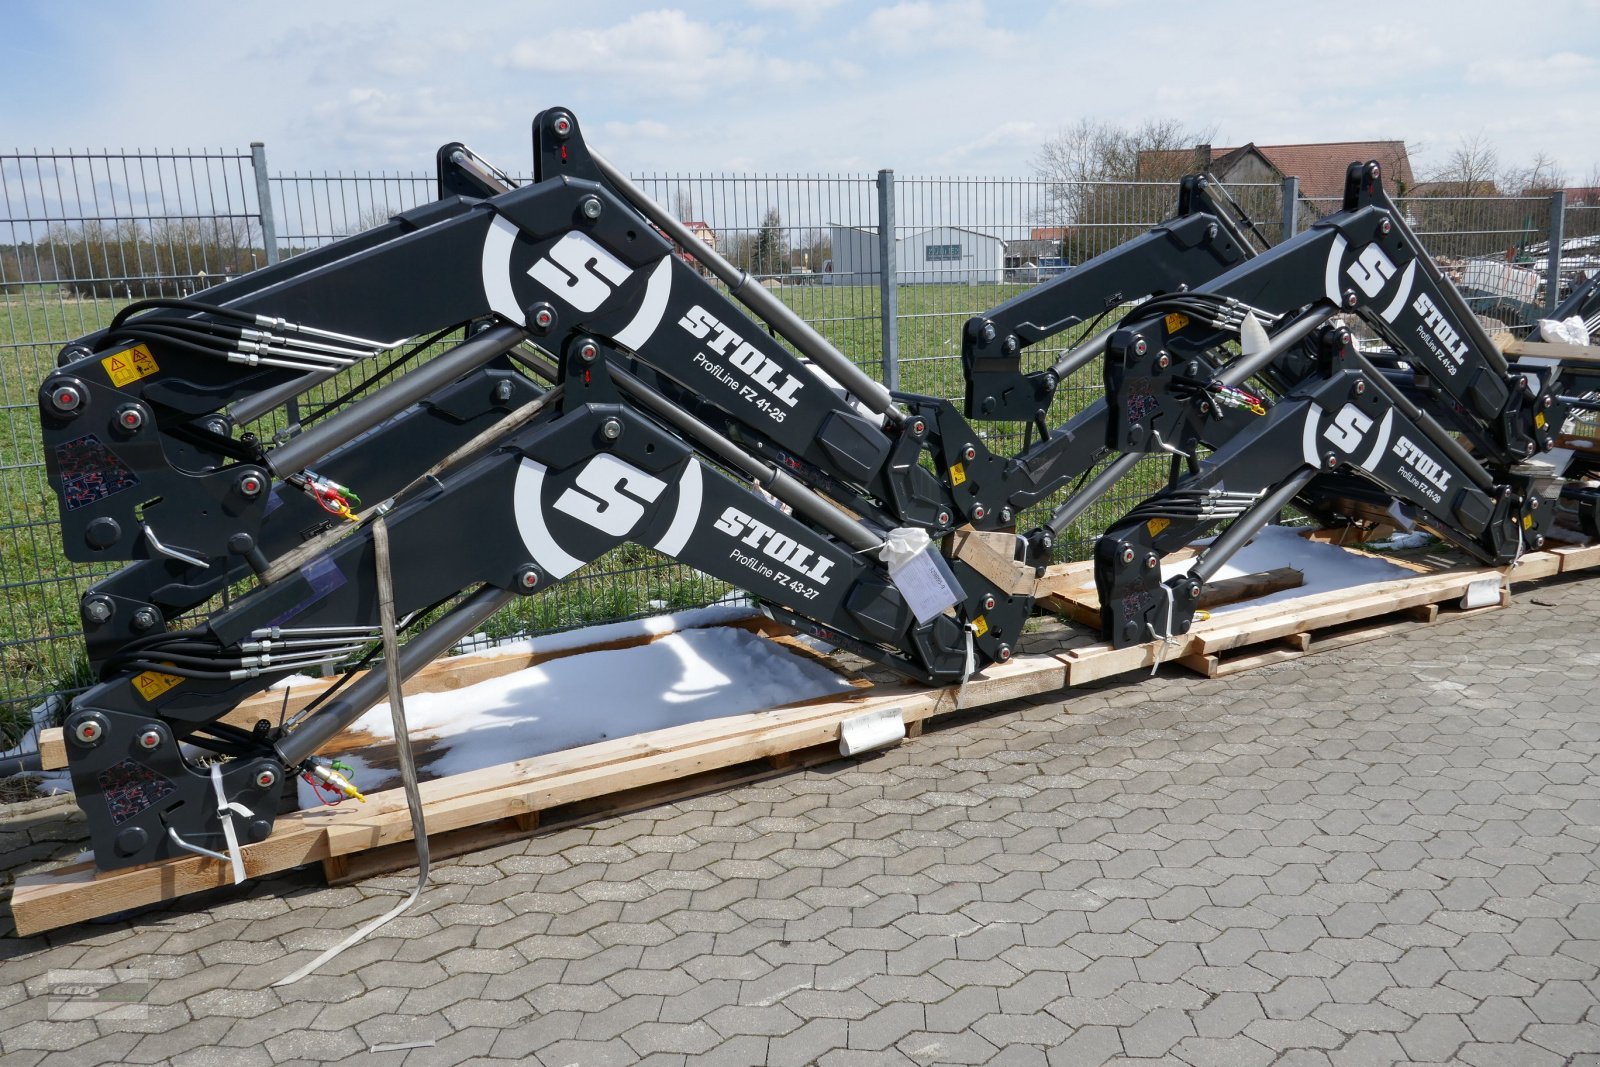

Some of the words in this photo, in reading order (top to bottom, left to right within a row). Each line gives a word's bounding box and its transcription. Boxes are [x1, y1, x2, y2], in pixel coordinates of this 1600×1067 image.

[526, 230, 634, 313] S
[1346, 242, 1398, 298] S
[677, 304, 805, 408] STOLL
[1412, 292, 1469, 366] STOLL
[1416, 325, 1437, 353] ProfiLine
[1435, 348, 1446, 361] FZ
[693, 351, 740, 391] ProfiLine
[739, 385, 759, 403] FZ
[756, 398, 787, 423] 41-25
[1323, 402, 1374, 454] S
[552, 452, 669, 537] S
[1392, 435, 1452, 492] STOLL
[1397, 465, 1420, 488] ProfiLine
[1418, 482, 1429, 494] FZ
[713, 506, 836, 586] STOLL
[729, 548, 773, 578] ProfiLine
[773, 571, 791, 586] FZ
[789, 580, 820, 600] 43-27
